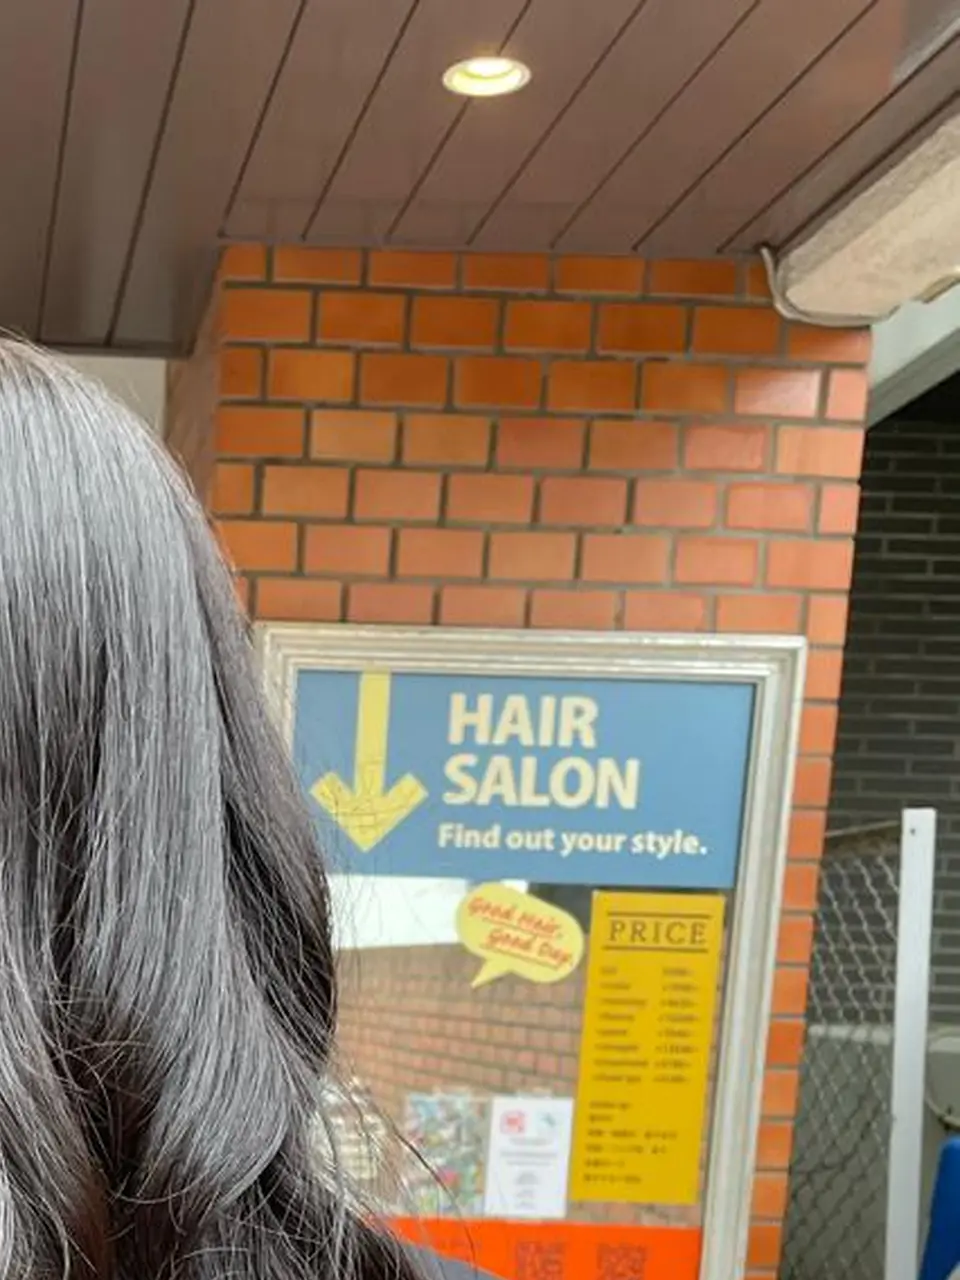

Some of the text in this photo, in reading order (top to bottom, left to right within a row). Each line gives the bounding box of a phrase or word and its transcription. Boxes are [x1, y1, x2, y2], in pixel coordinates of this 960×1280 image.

[449, 692, 599, 749] HAIR
[442, 752, 640, 810] SALON
[438, 821, 708, 861] Find out your style.
[608, 919, 708, 946] PRICE
